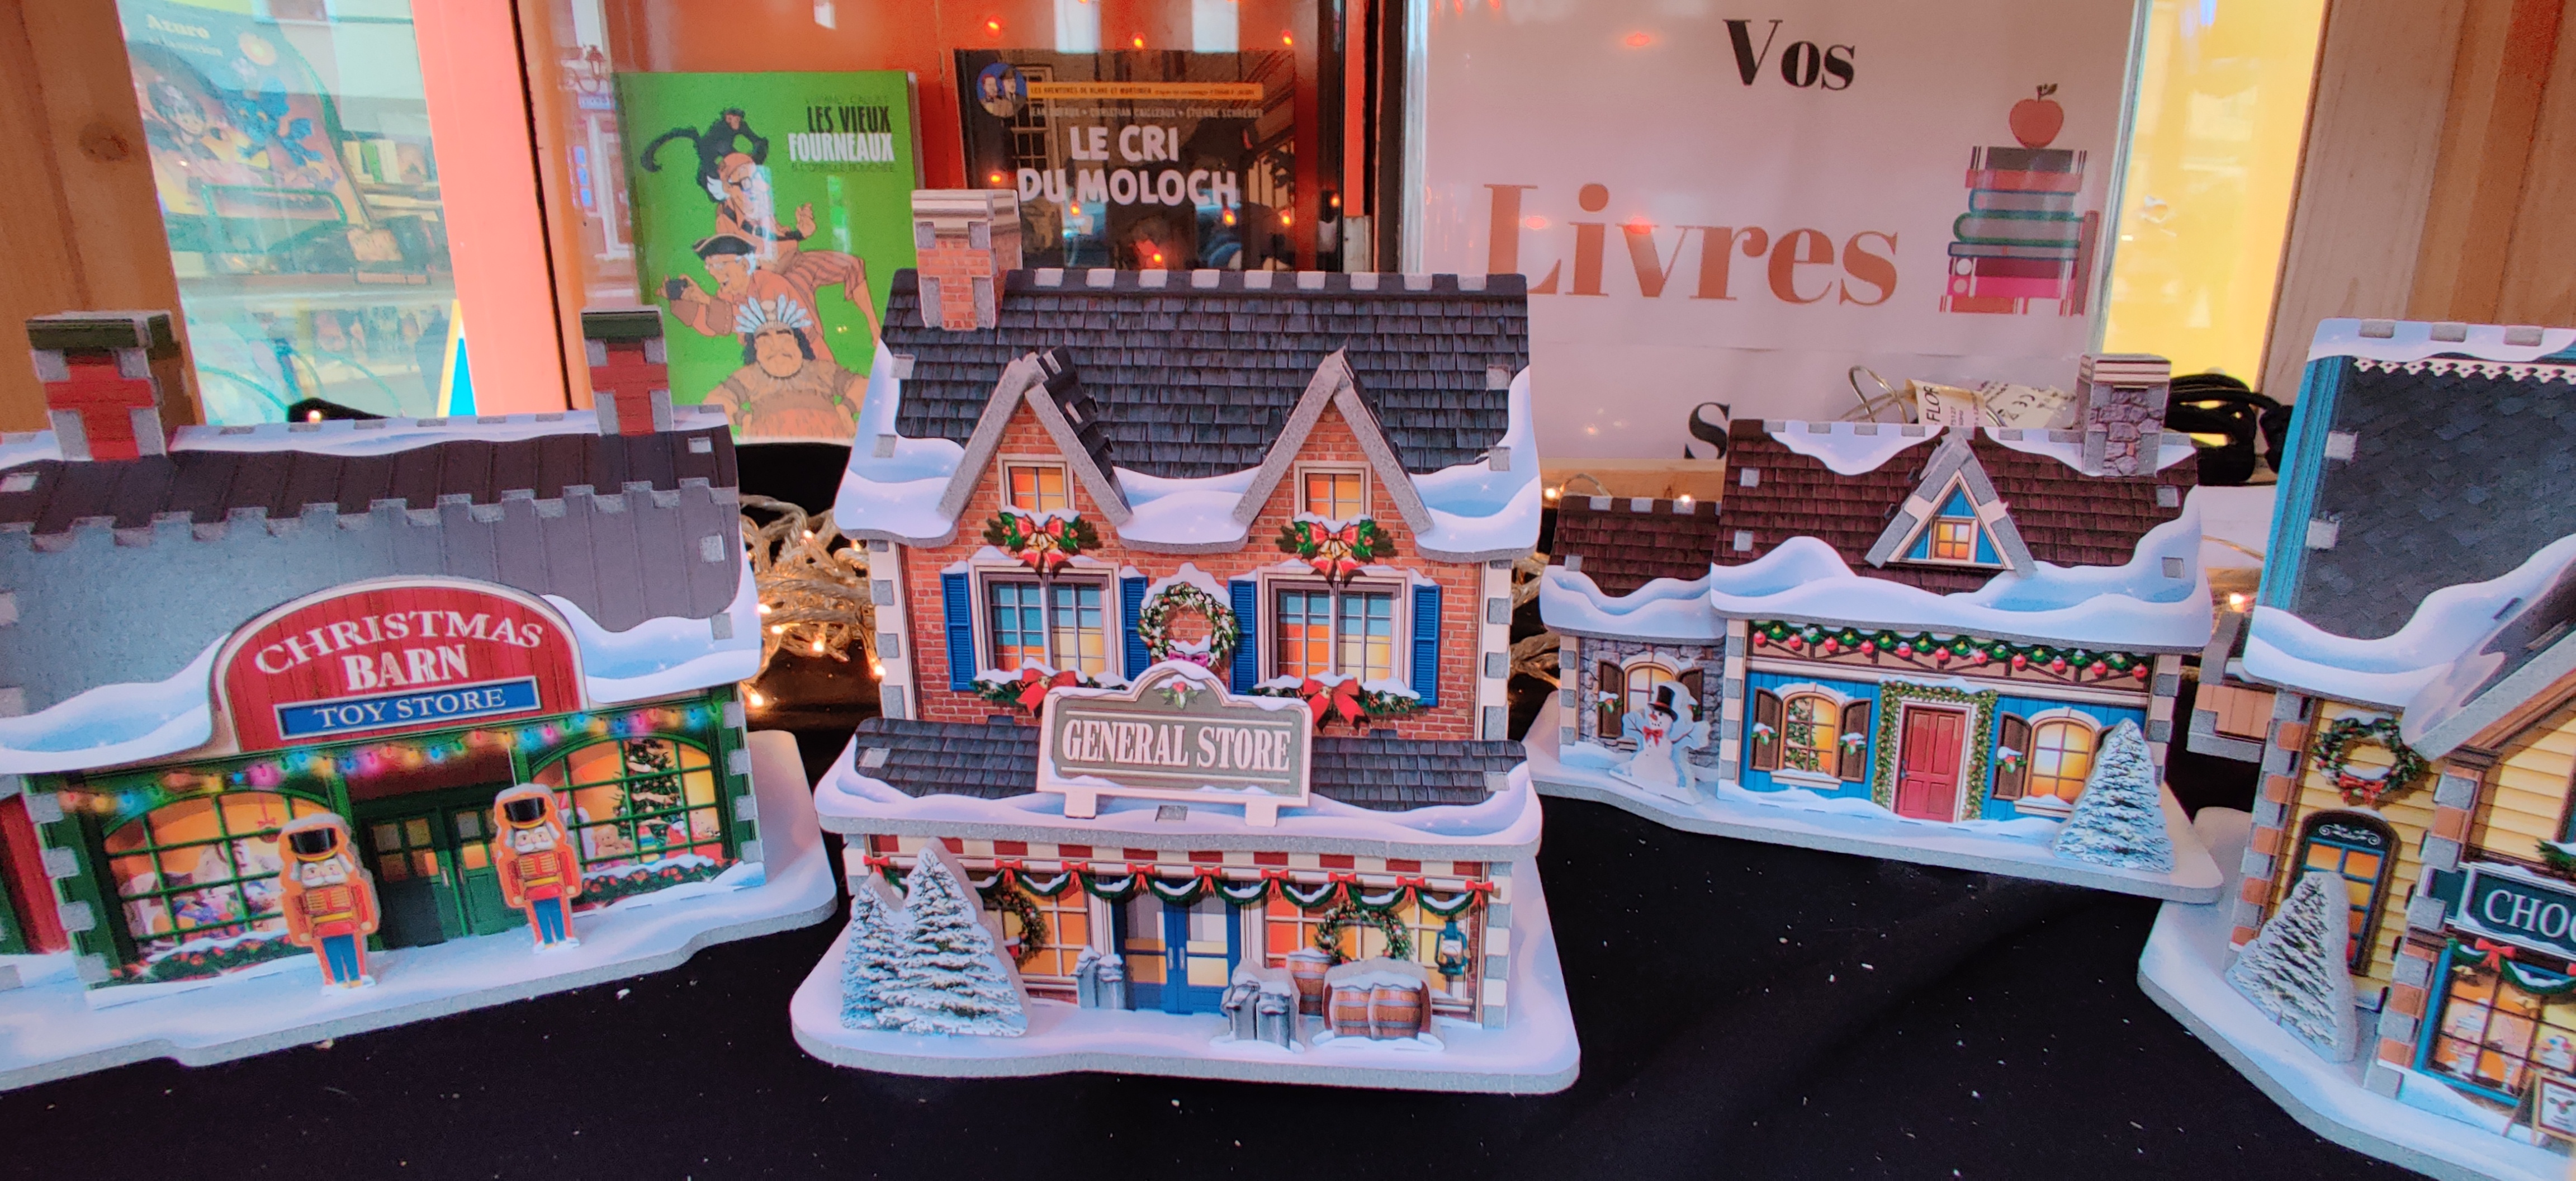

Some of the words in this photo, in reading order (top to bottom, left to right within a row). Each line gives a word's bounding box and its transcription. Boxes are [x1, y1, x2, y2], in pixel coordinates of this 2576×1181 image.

[1724, 18, 1856, 91] Vos
[807, 105, 834, 134] LES
[839, 105, 892, 134] VIEUX
[787, 132, 896, 162] FOURNEAUX
[1069, 126, 1110, 161] LE
[1119, 125, 1179, 162] CRI
[1017, 168, 1067, 203] DU
[1077, 169, 1238, 206] MOLOCH
[1484, 183, 1898, 306] Livres
[254, 610, 543, 674] CHRISTMAS
[342, 644, 469, 692] BARN
[313, 701, 388, 728] TOY
[396, 688, 506, 719] STORE
[1062, 719, 1190, 767] GENERAL
[1196, 726, 1292, 772] STORE
